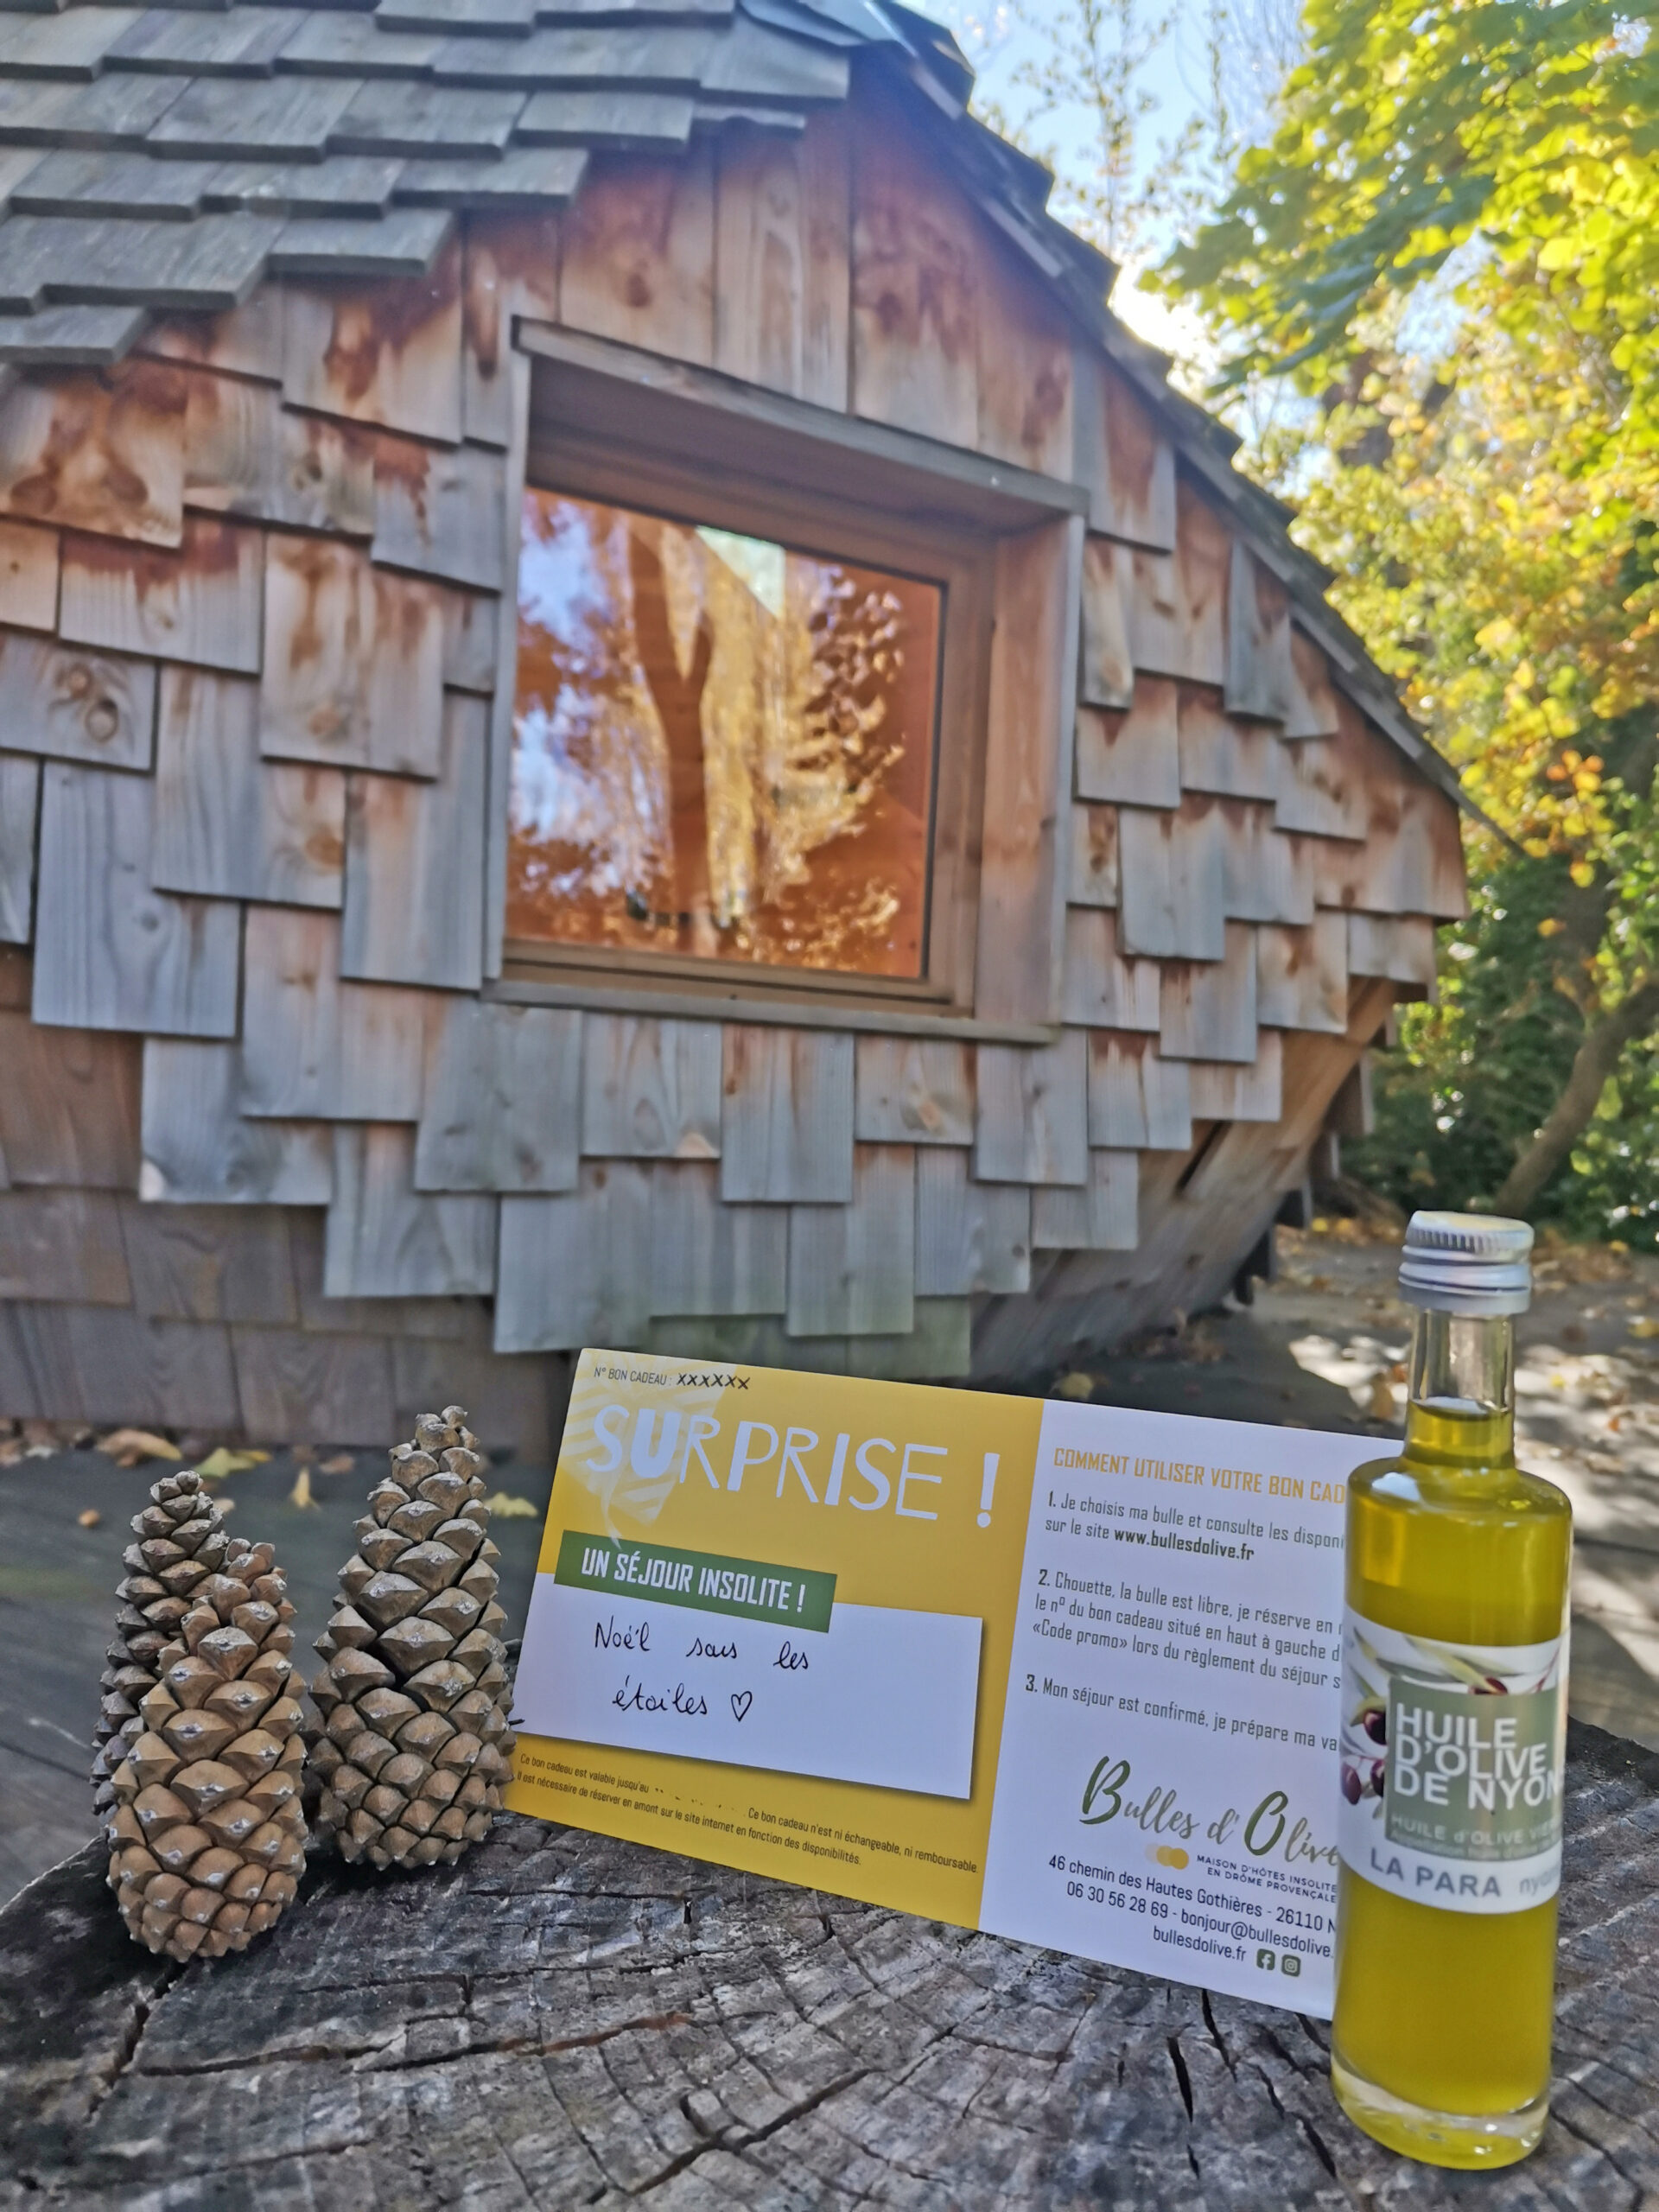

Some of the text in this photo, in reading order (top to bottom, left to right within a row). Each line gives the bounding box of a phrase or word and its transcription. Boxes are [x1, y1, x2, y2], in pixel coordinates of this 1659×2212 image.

[608, 1368, 628, 1381] BON
[630, 1370, 667, 1386] CADEAU
[586, 1403, 949, 1521] SURPRISE
[1053, 1447, 1129, 1475] COMMENT
[1134, 1458, 1205, 1486] UTILISER
[1211, 1467, 1262, 1493] VOTRE
[1268, 1475, 1305, 1499] BON
[1045, 1517, 1255, 1561] sur le site www.bullesdolive.fr
[1048, 1490, 1057, 1508] 1.
[1061, 1492, 1077, 1510] Je
[1080, 1496, 1125, 1517] choisis
[1128, 1506, 1148, 1521] ma
[1153, 1505, 1184, 1526] bulle
[1188, 1513, 1202, 1529] et
[1206, 1518, 1264, 1537] consulte
[1268, 1522, 1289, 1541] les
[581, 1547, 610, 1578] UN
[613, 1550, 694, 1593] SÉJOUR
[697, 1567, 792, 1611] INSOLITE
[1038, 1568, 1051, 1586] 2.
[1055, 1571, 1116, 1598] Chouette,
[1120, 1581, 1132, 1600] la
[1135, 1584, 1167, 1606] bulle
[1172, 1596, 1193, 1611] est
[1198, 1594, 1233, 1618] libre,
[1236, 1603, 1250, 1623] je
[1255, 1608, 1311, 1630] réserve
[1316, 1619, 1333, 1634] en
[594, 1615, 651, 1651] Noël
[773, 1641, 809, 1670] les
[1035, 1592, 1046, 1611] le
[1069, 1599, 1084, 1618] du
[1088, 1601, 1112, 1623] bon
[1116, 1610, 1163, 1631] cadeau
[1167, 1618, 1201, 1638] situé
[1205, 1627, 1222, 1641] en
[1226, 1625, 1257, 1648] haut
[1262, 1634, 1270, 1649] à
[1274, 1639, 1326, 1660] gauche
[1033, 1618, 1072, 1640] «Code
[1077, 1630, 1128, 1649] promo»
[1132, 1635, 1159, 1656] lors
[1163, 1641, 1179, 1660] du
[1184, 1648, 1255, 1675] règlement
[1260, 1657, 1276, 1678] du
[1281, 1666, 1329, 1686] séjour
[612, 1675, 708, 1715] étoiles
[1026, 1674, 1038, 1693] 3.
[1043, 1676, 1069, 1699] Mon
[1072, 1687, 1115, 1707] séjour
[1118, 1697, 1140, 1713] est
[1144, 1700, 1209, 1727] confirmé,
[1212, 1712, 1226, 1732] je
[1230, 1719, 1288, 1742] prépare
[1294, 1731, 1316, 1747] ma
[1395, 1703, 1518, 1749] HUILE
[1394, 1734, 1547, 1779] D'OLIVE
[1078, 1755, 1200, 1840] Bulles
[1394, 1764, 1449, 1806] DE
[519, 1752, 979, 1874] Ce bon cadeau est valable jusqu'au Ce bon cadeau n'est ni échangeable, ni remboursable.
[537, 1777, 577, 1796] nécessaire
[579, 1785, 588, 1797] de
[589, 1789, 620, 1806] réserver
[622, 1797, 632, 1808] en
[633, 1800, 659, 1815] amont
[660, 1807, 674, 1819] sur
[675, 1808, 683, 1821] le
[684, 1811, 701, 1826] site
[702, 1815, 734, 1832] internet
[735, 1826, 747, 1837] en
[748, 1827, 784, 1847] fonction
[785, 1835, 800, 1850] des
[802, 1841, 862, 1866] disponibilités.
[1197, 1854, 1237, 1871] MAISON
[1241, 1865, 1286, 1882] D'HÔTES
[1207, 1867, 1337, 1904] EN DRÔME PROVENÇALE
[1370, 1847, 1404, 1881] LA
[1048, 1854, 1065, 1871] 46
[1069, 1860, 1116, 1883] chemin
[1119, 1872, 1142, 1889] des
[1146, 1877, 1193, 1901] Hautes
[1197, 1888, 1262, 1917] Gothières
[1275, 1906, 1323, 1931] 26110
[1066, 1880, 1084, 1898] 06
[1087, 1885, 1104, 1904] 30
[1108, 1891, 1125, 1908] 56
[1128, 1896, 1147, 1913] 28
[1150, 1901, 1169, 1919] 69
[1153, 1925, 1247, 1961] bullesdolive.fr
